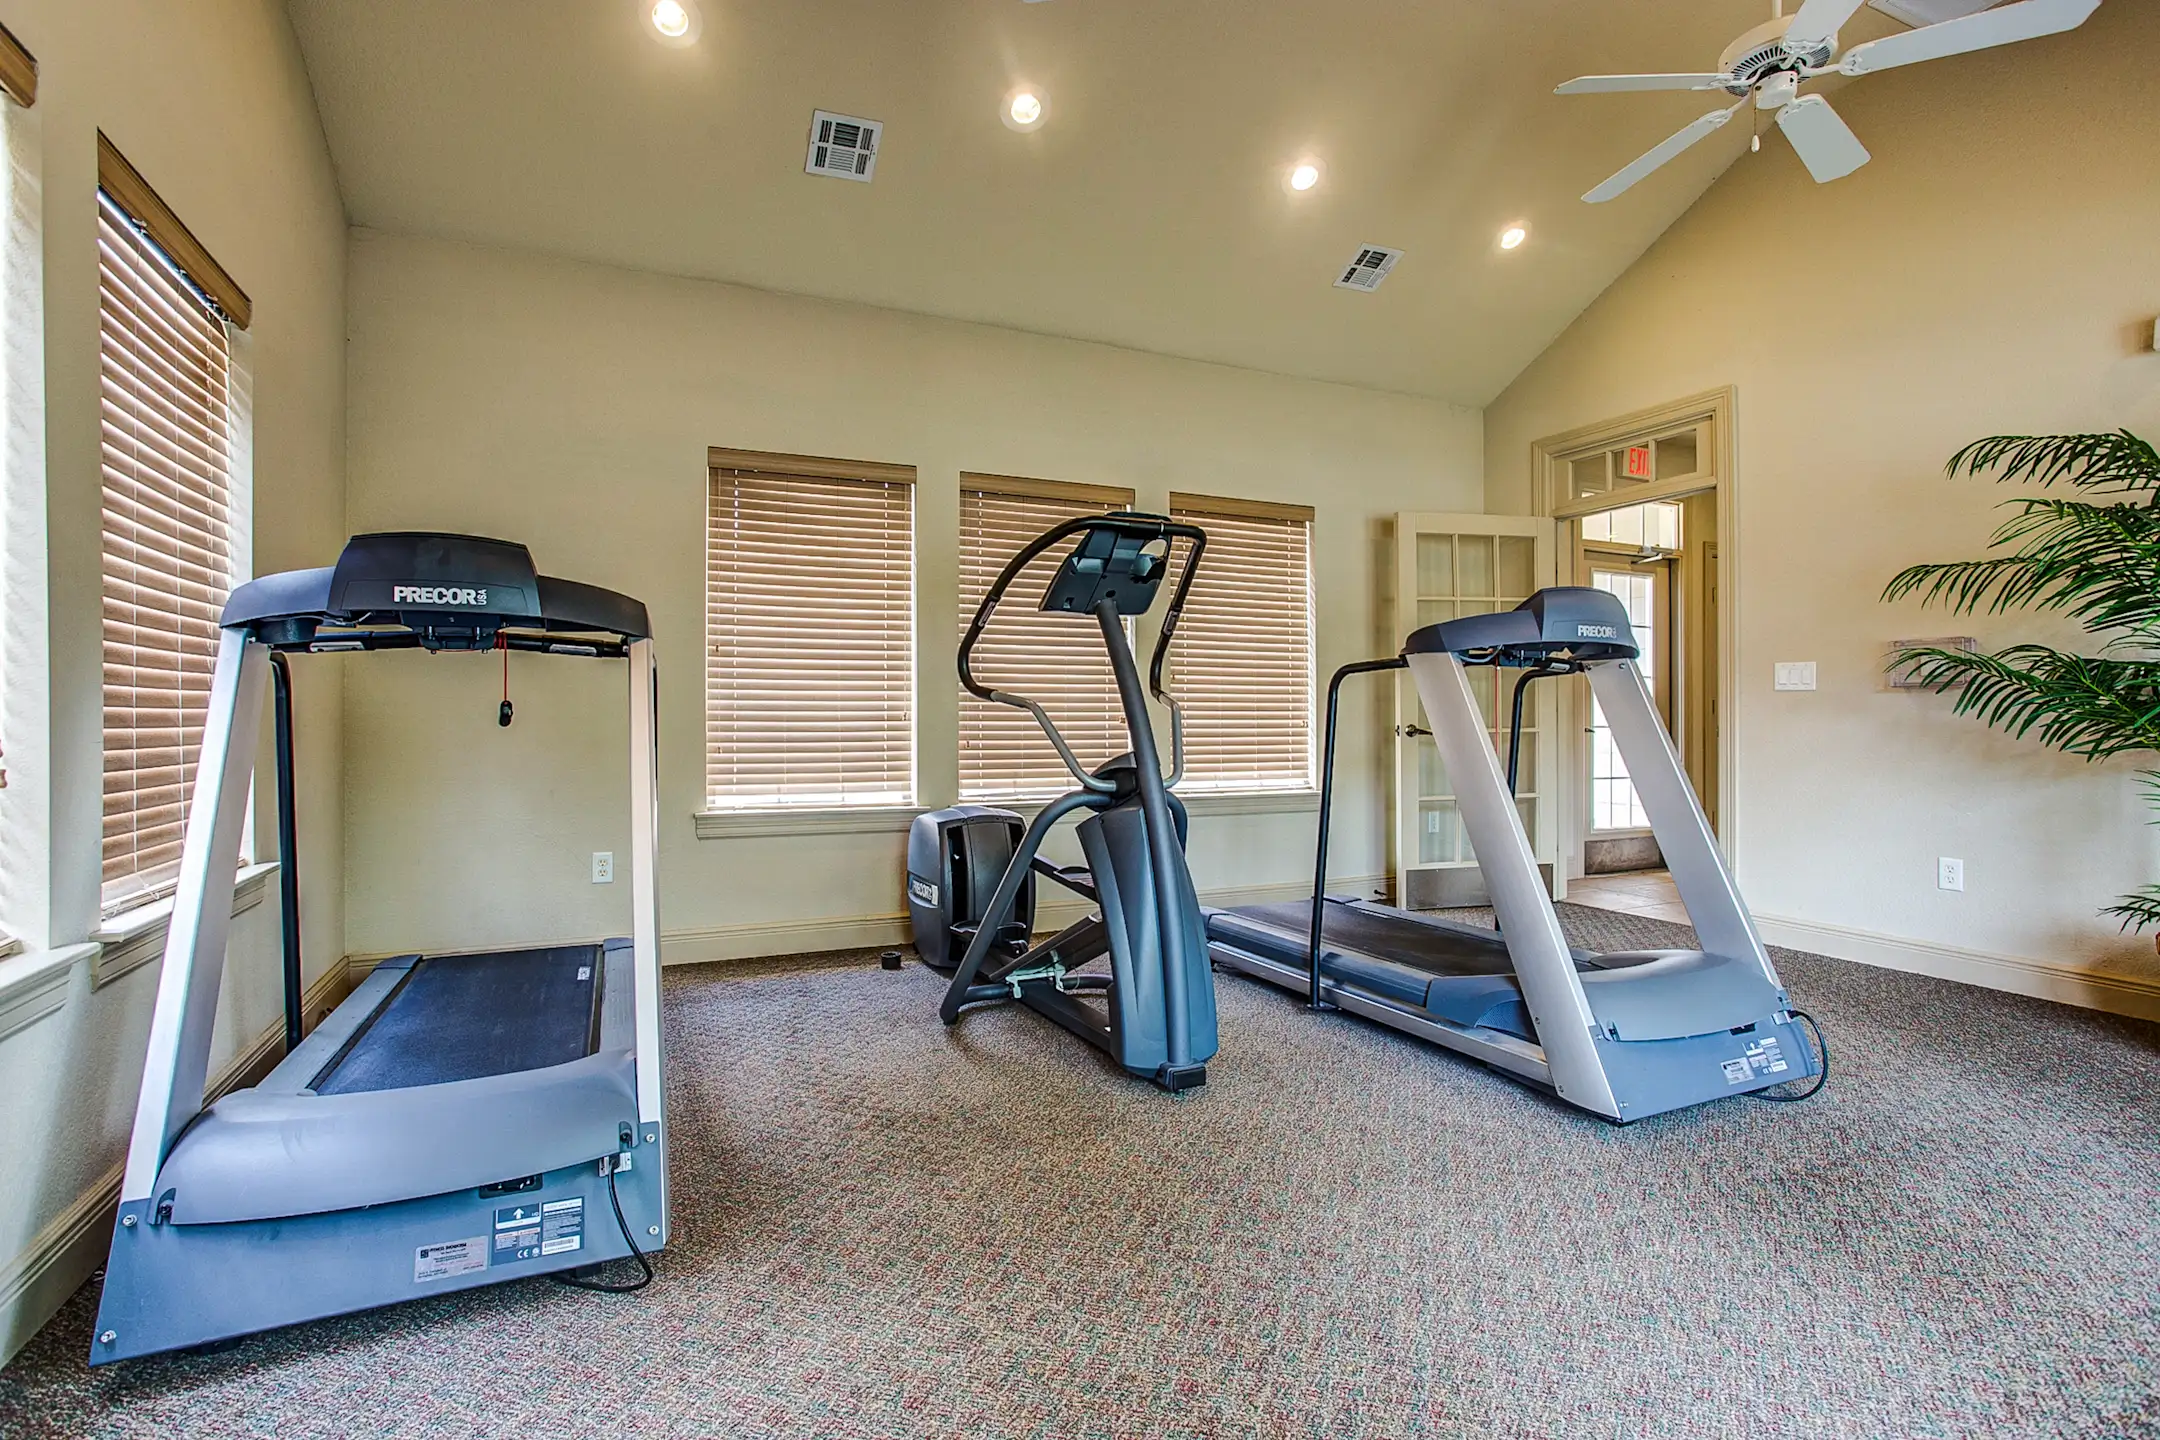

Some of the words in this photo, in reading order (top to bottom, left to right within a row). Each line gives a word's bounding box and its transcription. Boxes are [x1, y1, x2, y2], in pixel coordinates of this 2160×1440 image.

[394, 586, 478, 606] PRECOR
[477, 588, 488, 606] USA
[1577, 624, 1613, 638] PRECOR
